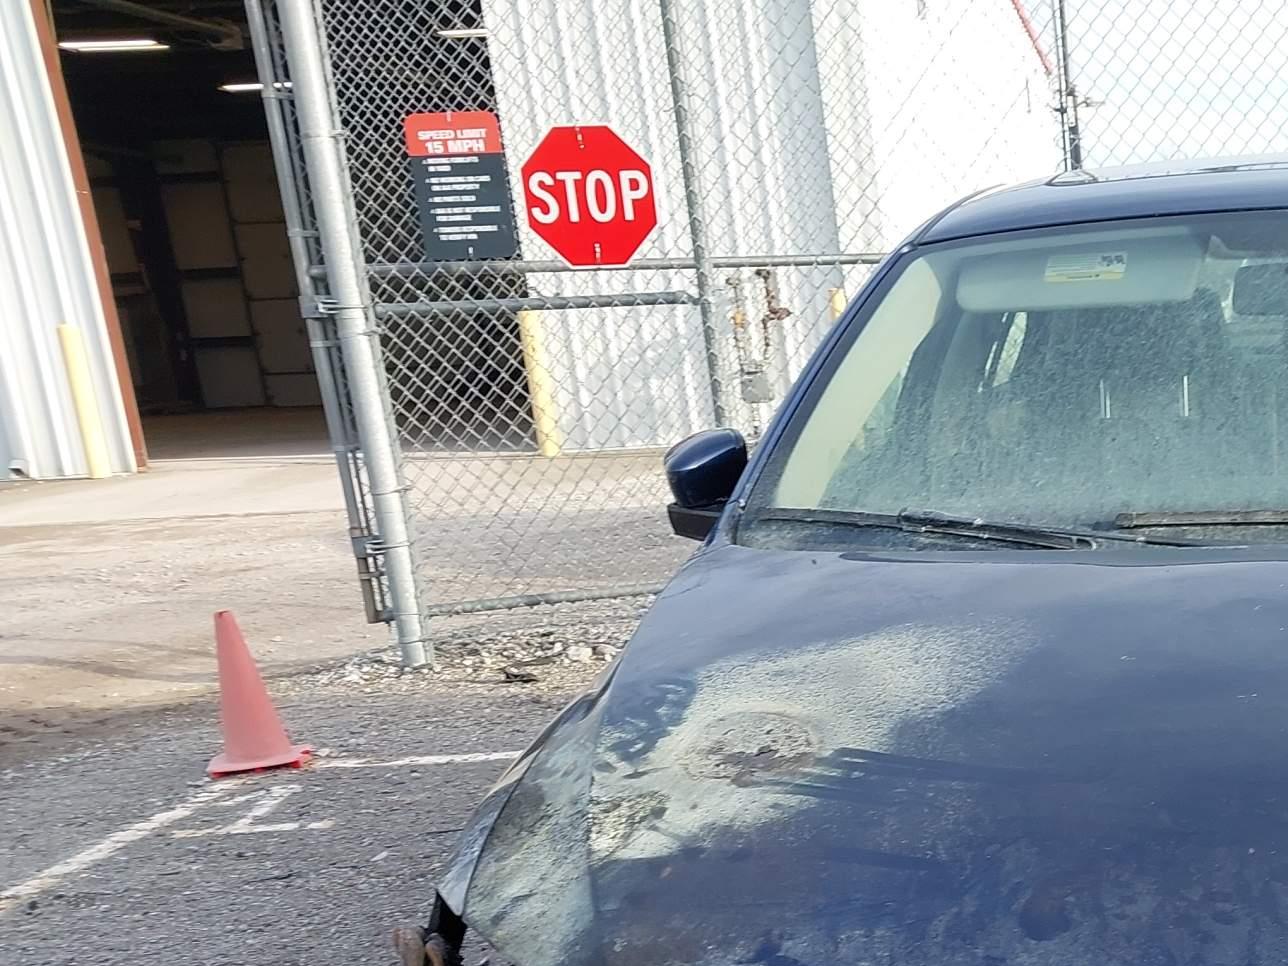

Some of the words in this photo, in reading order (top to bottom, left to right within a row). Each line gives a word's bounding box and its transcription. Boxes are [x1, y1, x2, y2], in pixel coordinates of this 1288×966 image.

[417, 130, 455, 140] SPEED
[425, 141, 444, 153] 15
[447, 139, 486, 153] MPH
[528, 169, 649, 224] STOP
